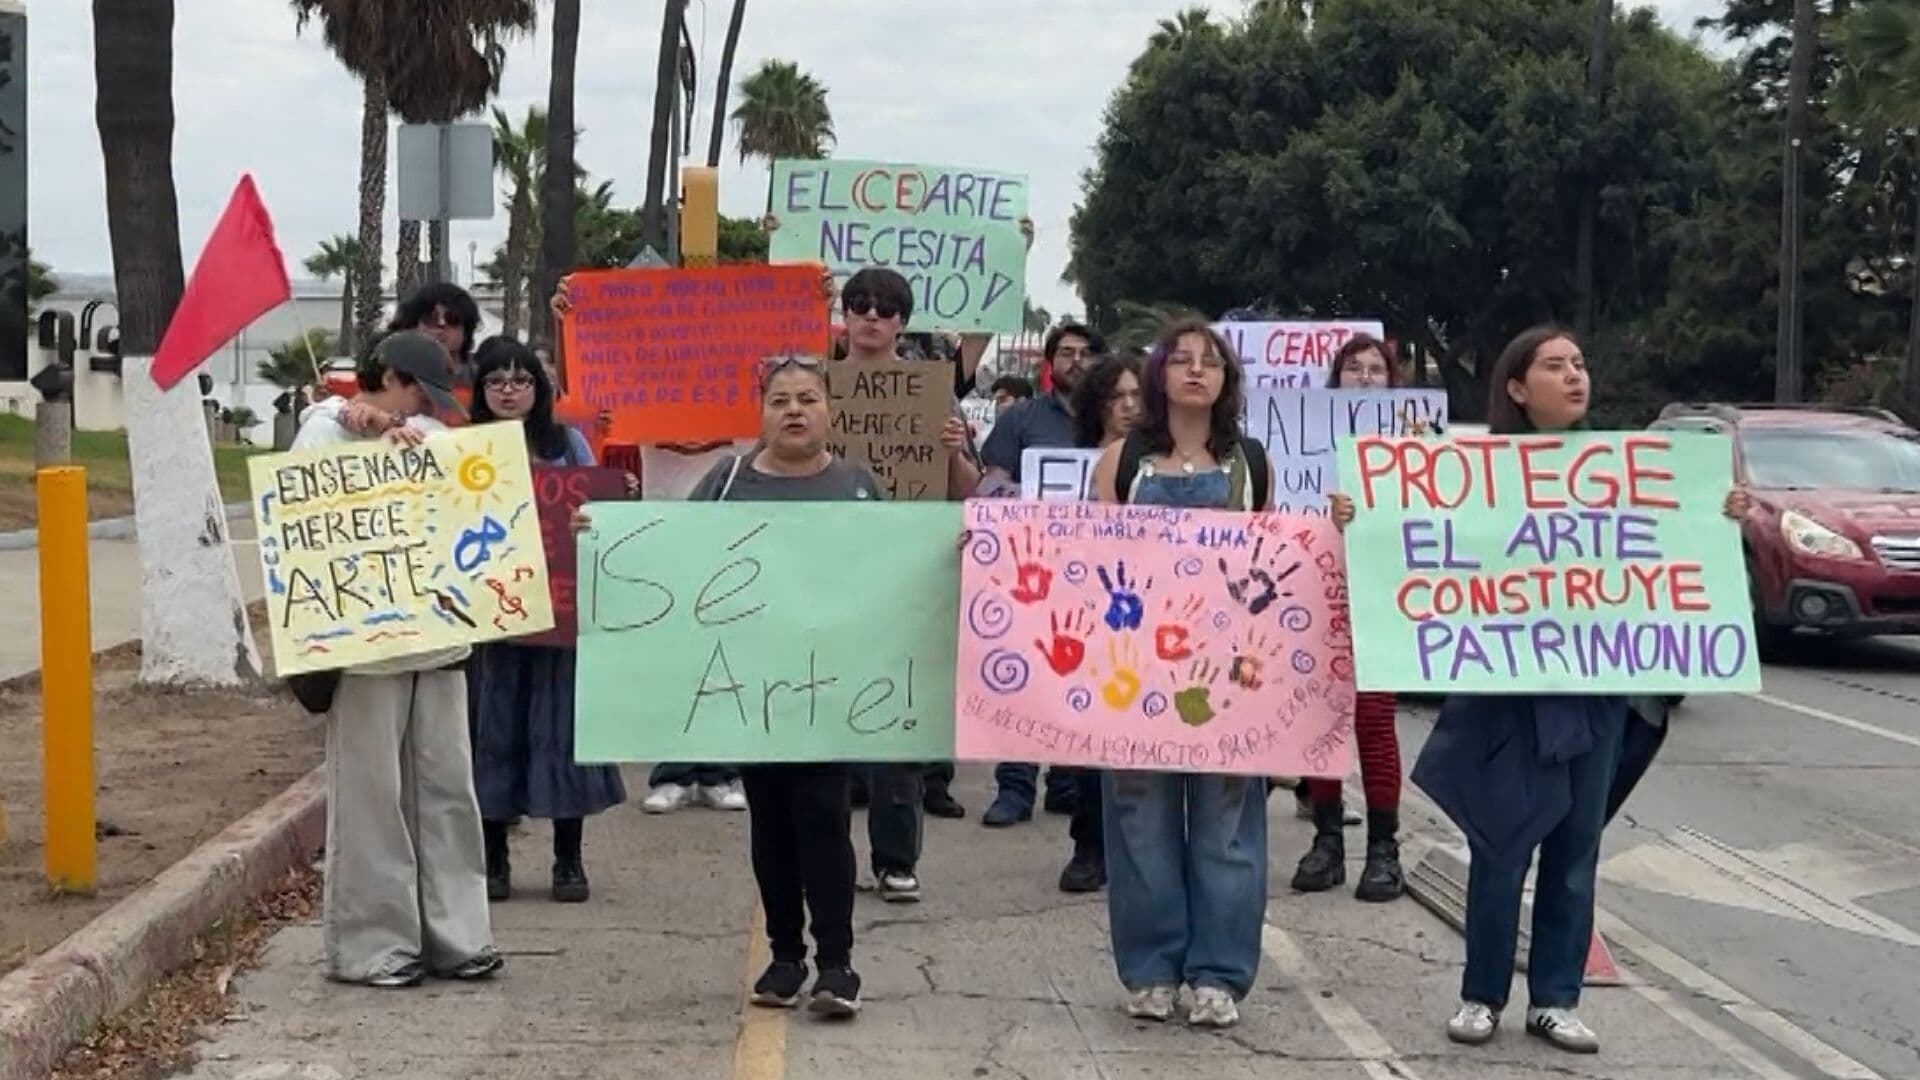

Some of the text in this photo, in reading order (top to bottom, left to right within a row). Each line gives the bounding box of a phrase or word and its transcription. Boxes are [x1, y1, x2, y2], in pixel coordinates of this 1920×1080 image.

[787, 170, 849, 213] EL
[819, 220, 985, 276] NECESITA
[853, 370, 923, 400] ARTE
[276, 449, 445, 505] ENSENADA
[1284, 465, 1321, 495] UN
[1356, 436, 1681, 509] PROTEGE
[280, 502, 410, 551] MERECE
[1402, 511, 1663, 570] EL ARTE
[283, 541, 430, 628] ARTE
[1397, 563, 1712, 622] CONSTRUYE
[1417, 619, 1747, 682] PATRIMONIO
[683, 639, 916, 735] Arte!
